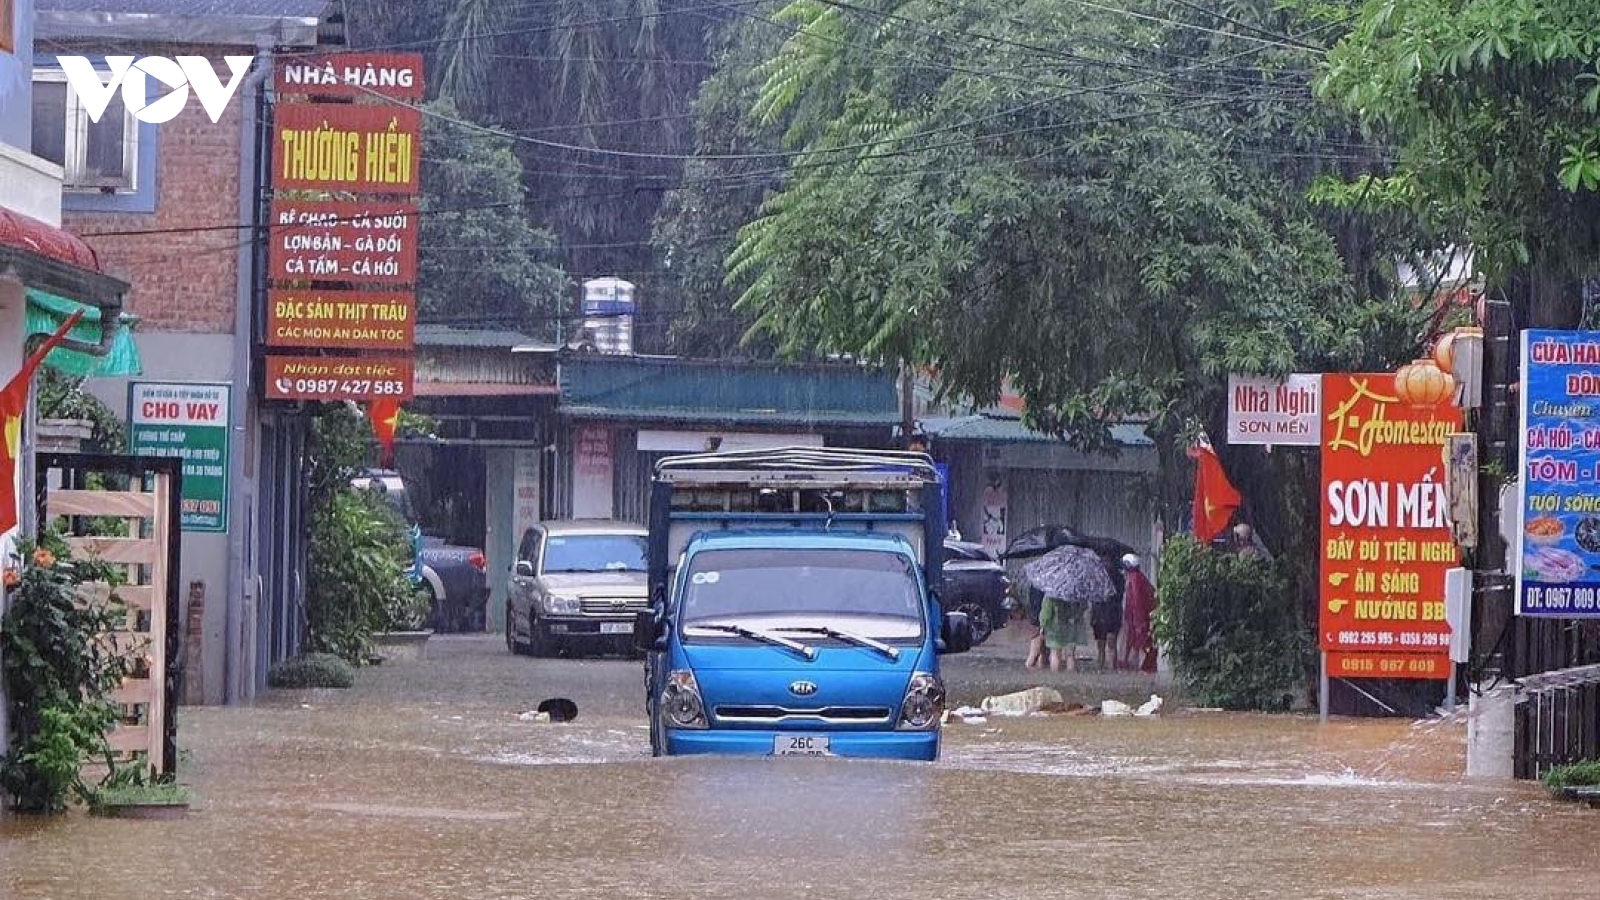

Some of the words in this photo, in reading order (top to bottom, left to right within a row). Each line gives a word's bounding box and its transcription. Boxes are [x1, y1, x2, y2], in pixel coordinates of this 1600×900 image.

[285, 62, 337, 85] NHÀ
[344, 63, 413, 87] HÀNG
[282, 120, 359, 181] THƯỜNG
[366, 116, 412, 183] HIỀN
[352, 211, 371, 228] CÁ
[375, 210, 407, 229] SUỐI
[284, 235, 311, 253] LỢN
[355, 235, 373, 252] GÀ
[285, 256, 304, 273] CÁ
[352, 257, 371, 275] CÁ
[275, 297, 303, 321] ĐẶC
[307, 297, 333, 319] SẢN
[338, 302, 369, 324] THỊT
[372, 299, 407, 321] TRÂU
[277, 326, 301, 338] CÁC
[1532, 336, 1570, 363] CỬA
[295, 379, 337, 393] 0987
[340, 380, 371, 394] 427
[374, 381, 404, 395] 583
[1235, 385, 1269, 412] Nhà
[1276, 383, 1316, 416] Nghỉ
[142, 402, 180, 419] CHO
[186, 403, 218, 420] VAY
[1239, 421, 1271, 433] SƠN
[1276, 418, 1309, 433] MẾN
[1527, 423, 1546, 449] CÁ
[1548, 421, 1572, 449] HỒI
[1528, 455, 1577, 481] TÔM
[1328, 477, 1389, 527] SƠN
[1396, 466, 1452, 528] MẾN
[1326, 532, 1355, 560] ĐẦY
[1360, 535, 1379, 560] ĐỦ
[1384, 537, 1416, 564] TIỆN
[1354, 567, 1375, 593] ĂN
[1381, 568, 1419, 593] SÁNG
[1354, 595, 1417, 620] NƯỚNG
[1422, 601, 1446, 620] BB
[1545, 587, 1572, 608] 0967
[1574, 587, 1595, 609] 809
[1422, 632, 1437, 645] 209
[1440, 633, 1450, 646] 98
[1342, 658, 1374, 671] 0915
[793, 682, 813, 694] KIA
[790, 737, 813, 749] 26C
